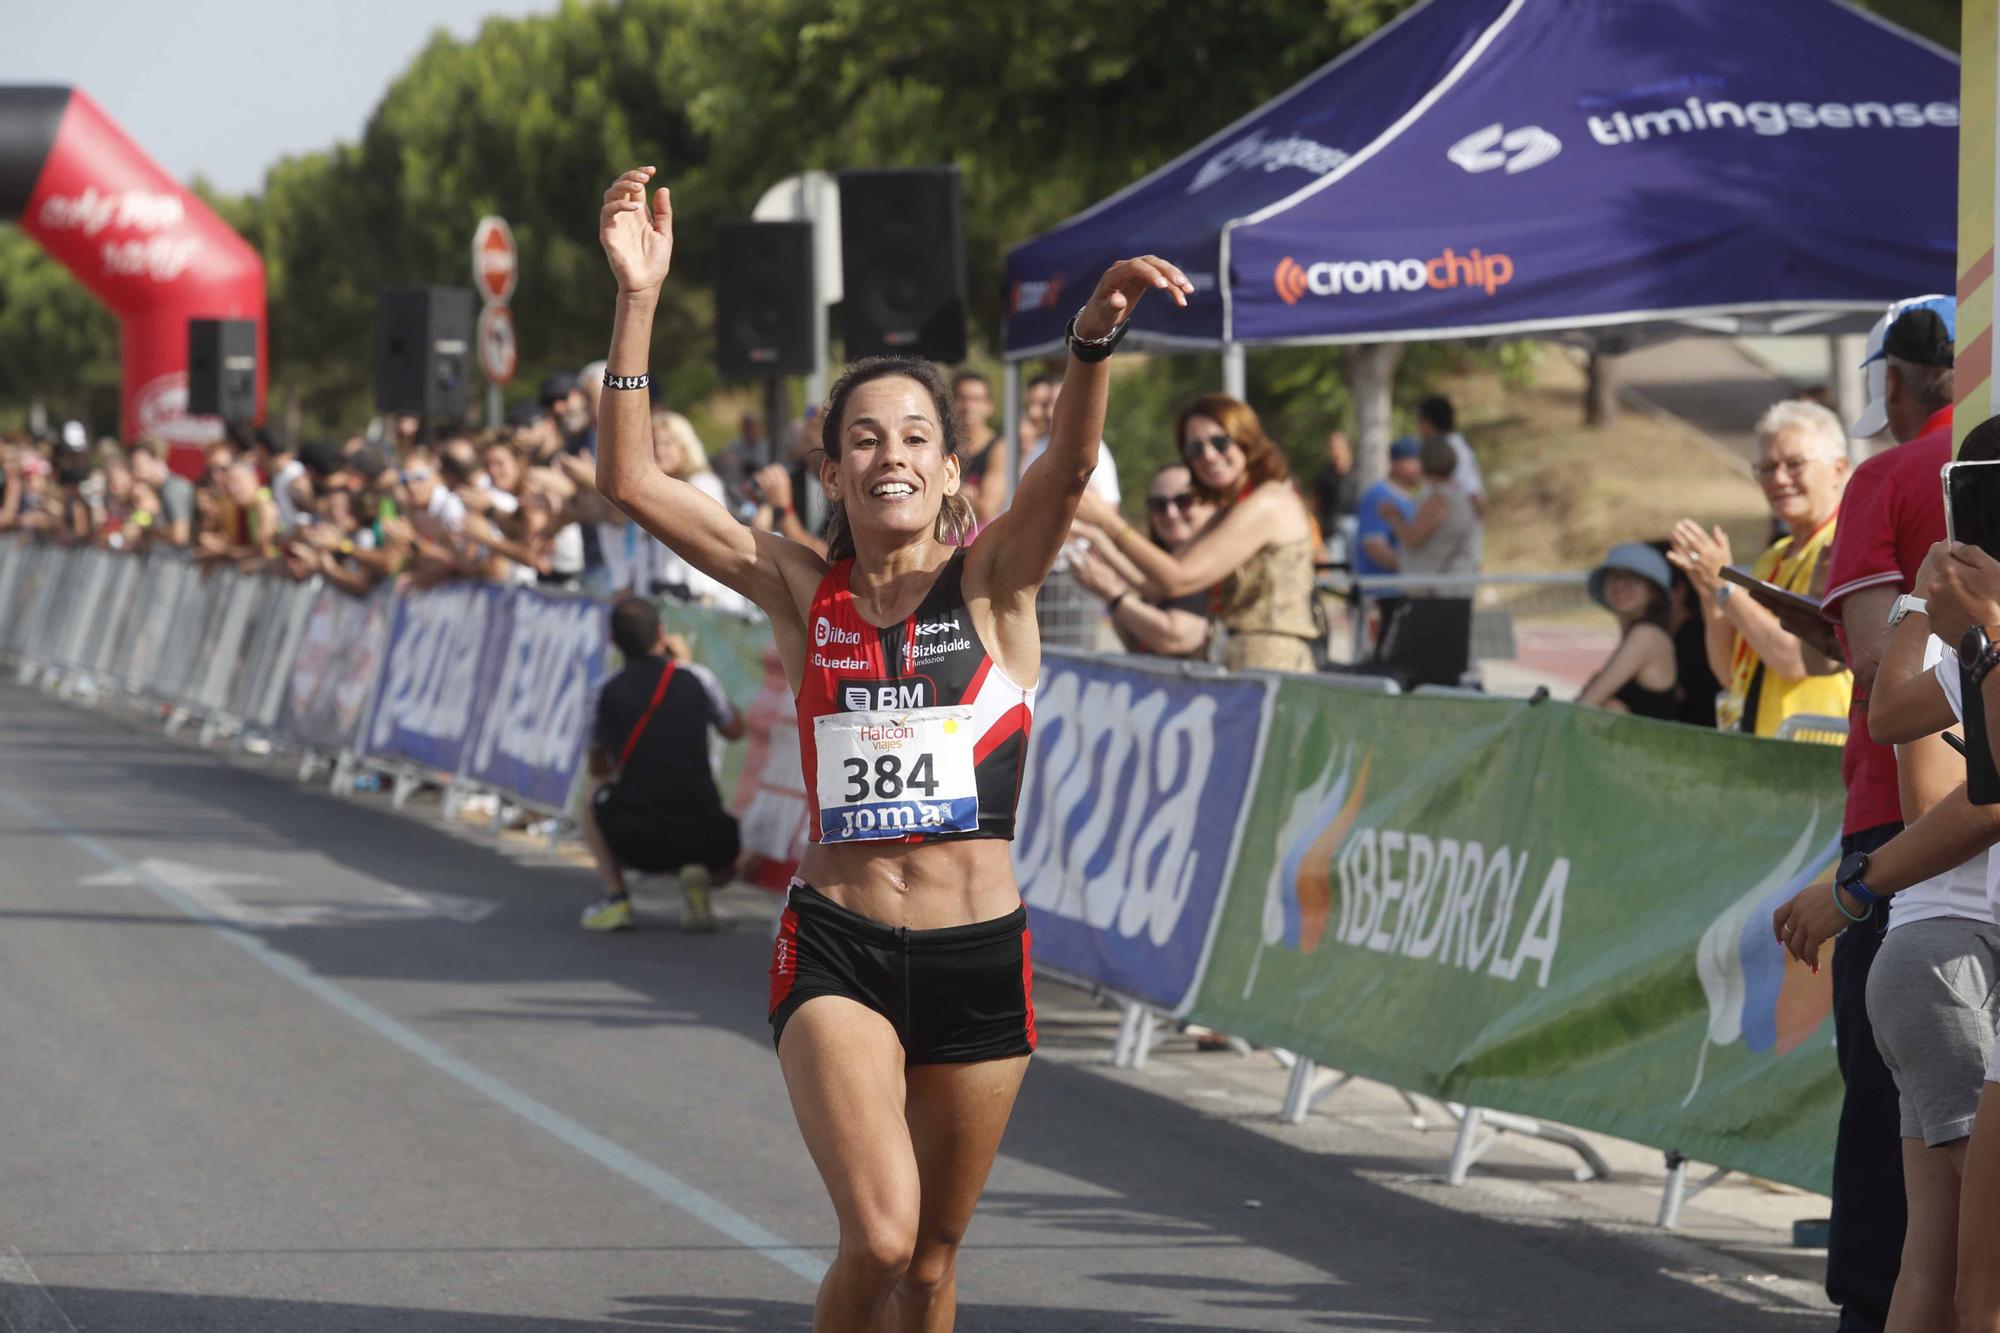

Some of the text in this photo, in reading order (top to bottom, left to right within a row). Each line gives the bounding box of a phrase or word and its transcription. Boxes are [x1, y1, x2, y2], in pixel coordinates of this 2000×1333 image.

[1587, 97, 1960, 145] timingsense
[1307, 248, 1514, 296] cronochip
[815, 616, 860, 647] Bilbao
[912, 637, 971, 658] Bizkaialde
[814, 653, 869, 670] Guedan
[877, 682, 924, 711] BM
[843, 753, 939, 803] 384
[1013, 664, 1218, 947] oma
[1337, 827, 1570, 989] IBERDROLA
